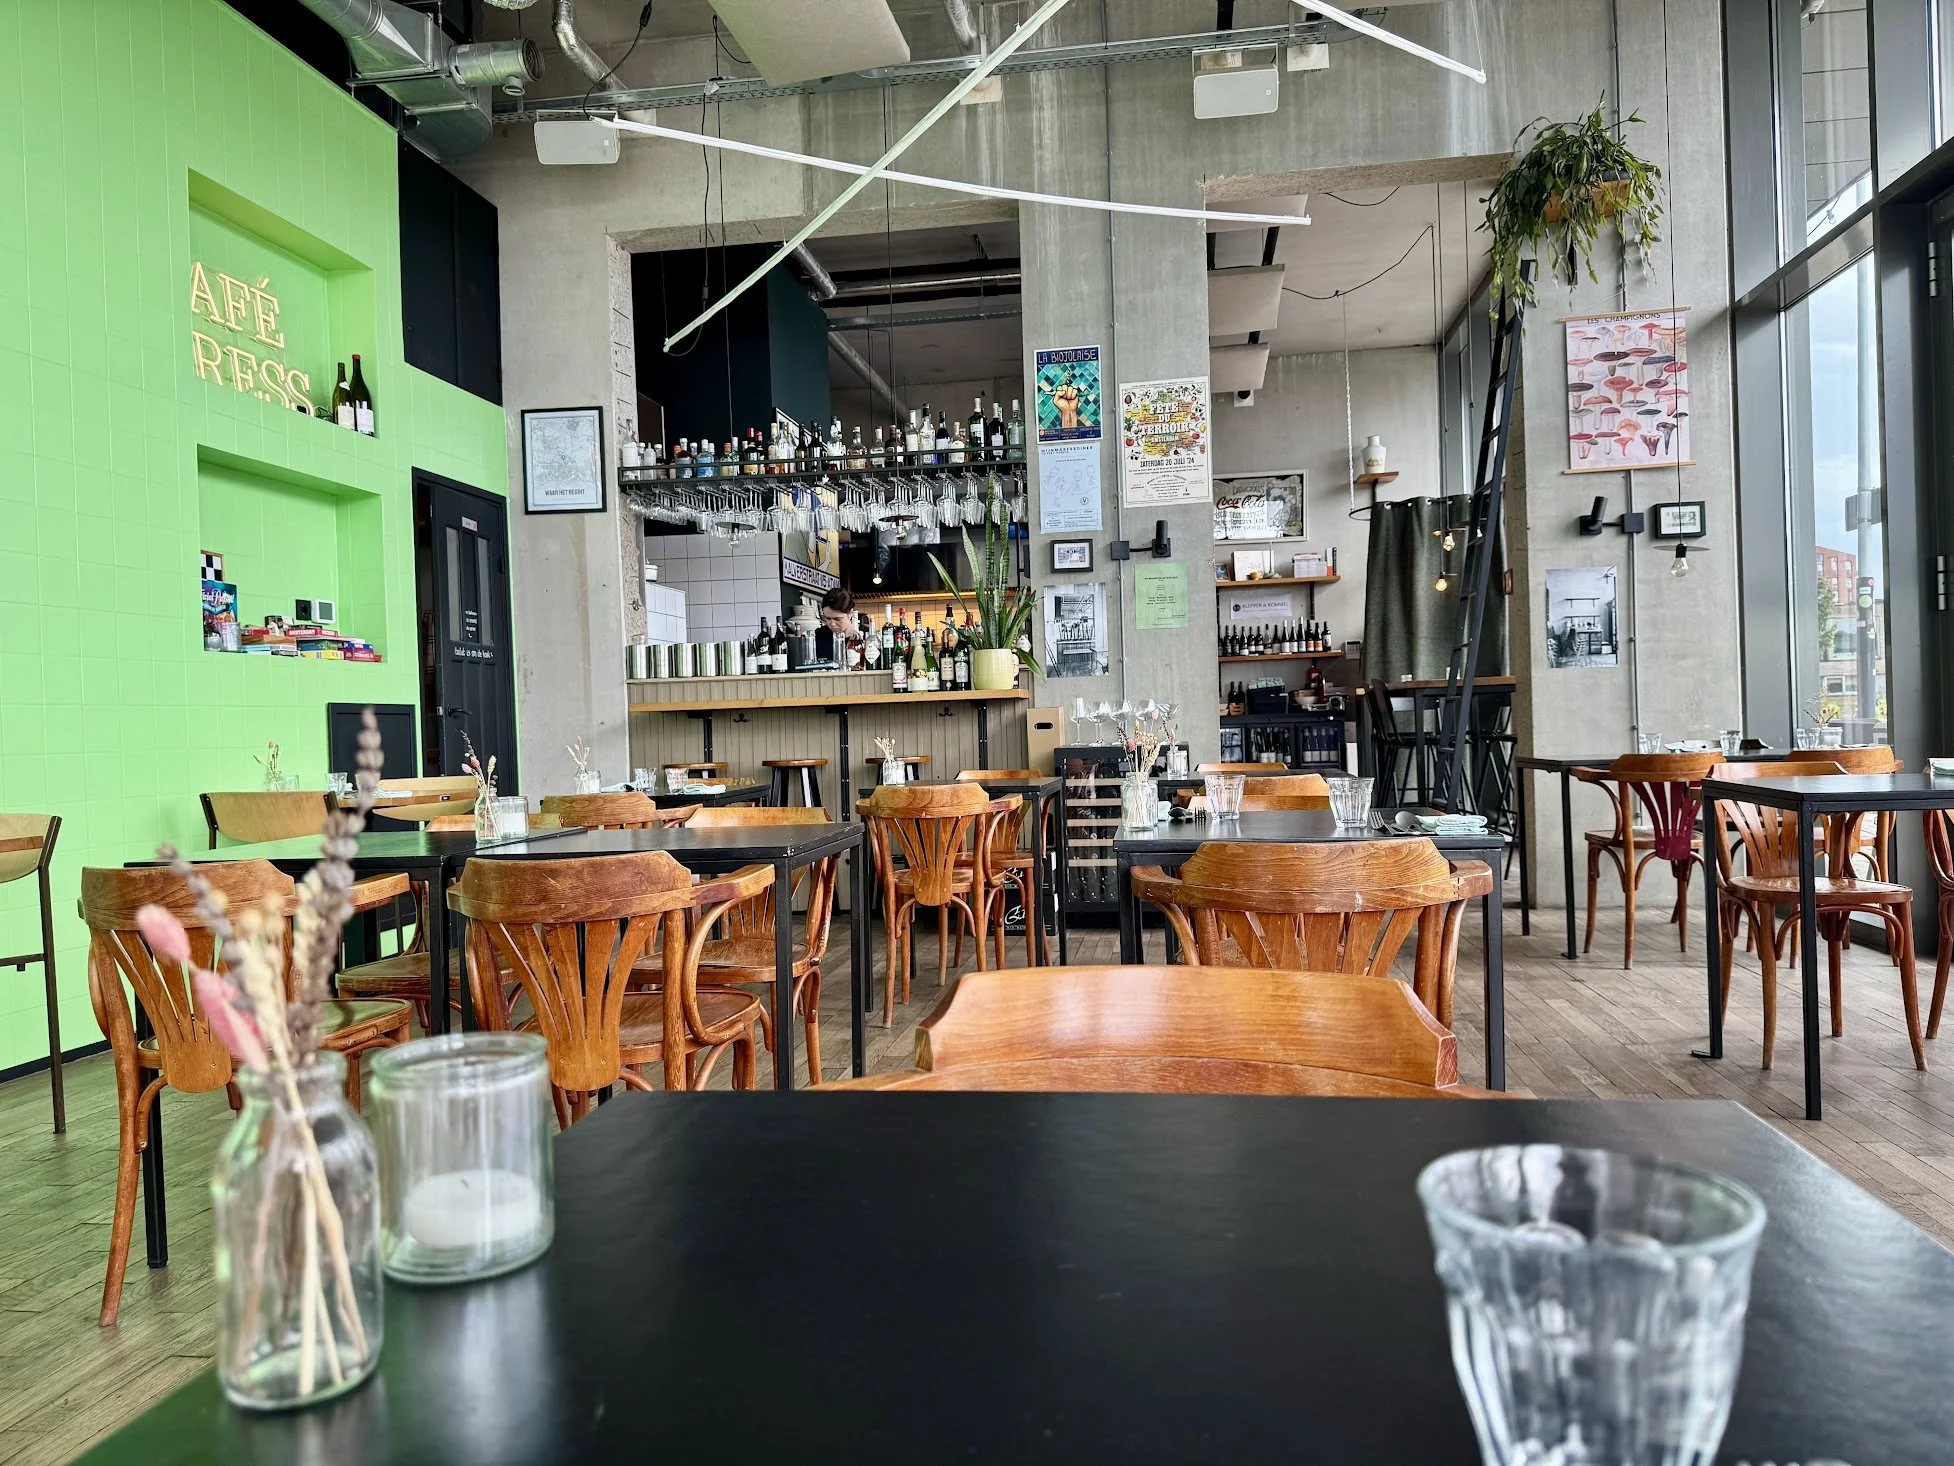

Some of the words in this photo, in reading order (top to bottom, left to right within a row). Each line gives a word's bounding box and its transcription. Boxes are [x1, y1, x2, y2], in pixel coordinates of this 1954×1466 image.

[1605, 312, 1661, 323] CHAMPIGNONS
[1038, 353, 1048, 363] LA
[1151, 401, 1179, 414] FÊTE
[1159, 414, 1171, 422] DU
[1141, 422, 1190, 435] TERROIR
[1140, 459, 1164, 467] ZATERDAG
